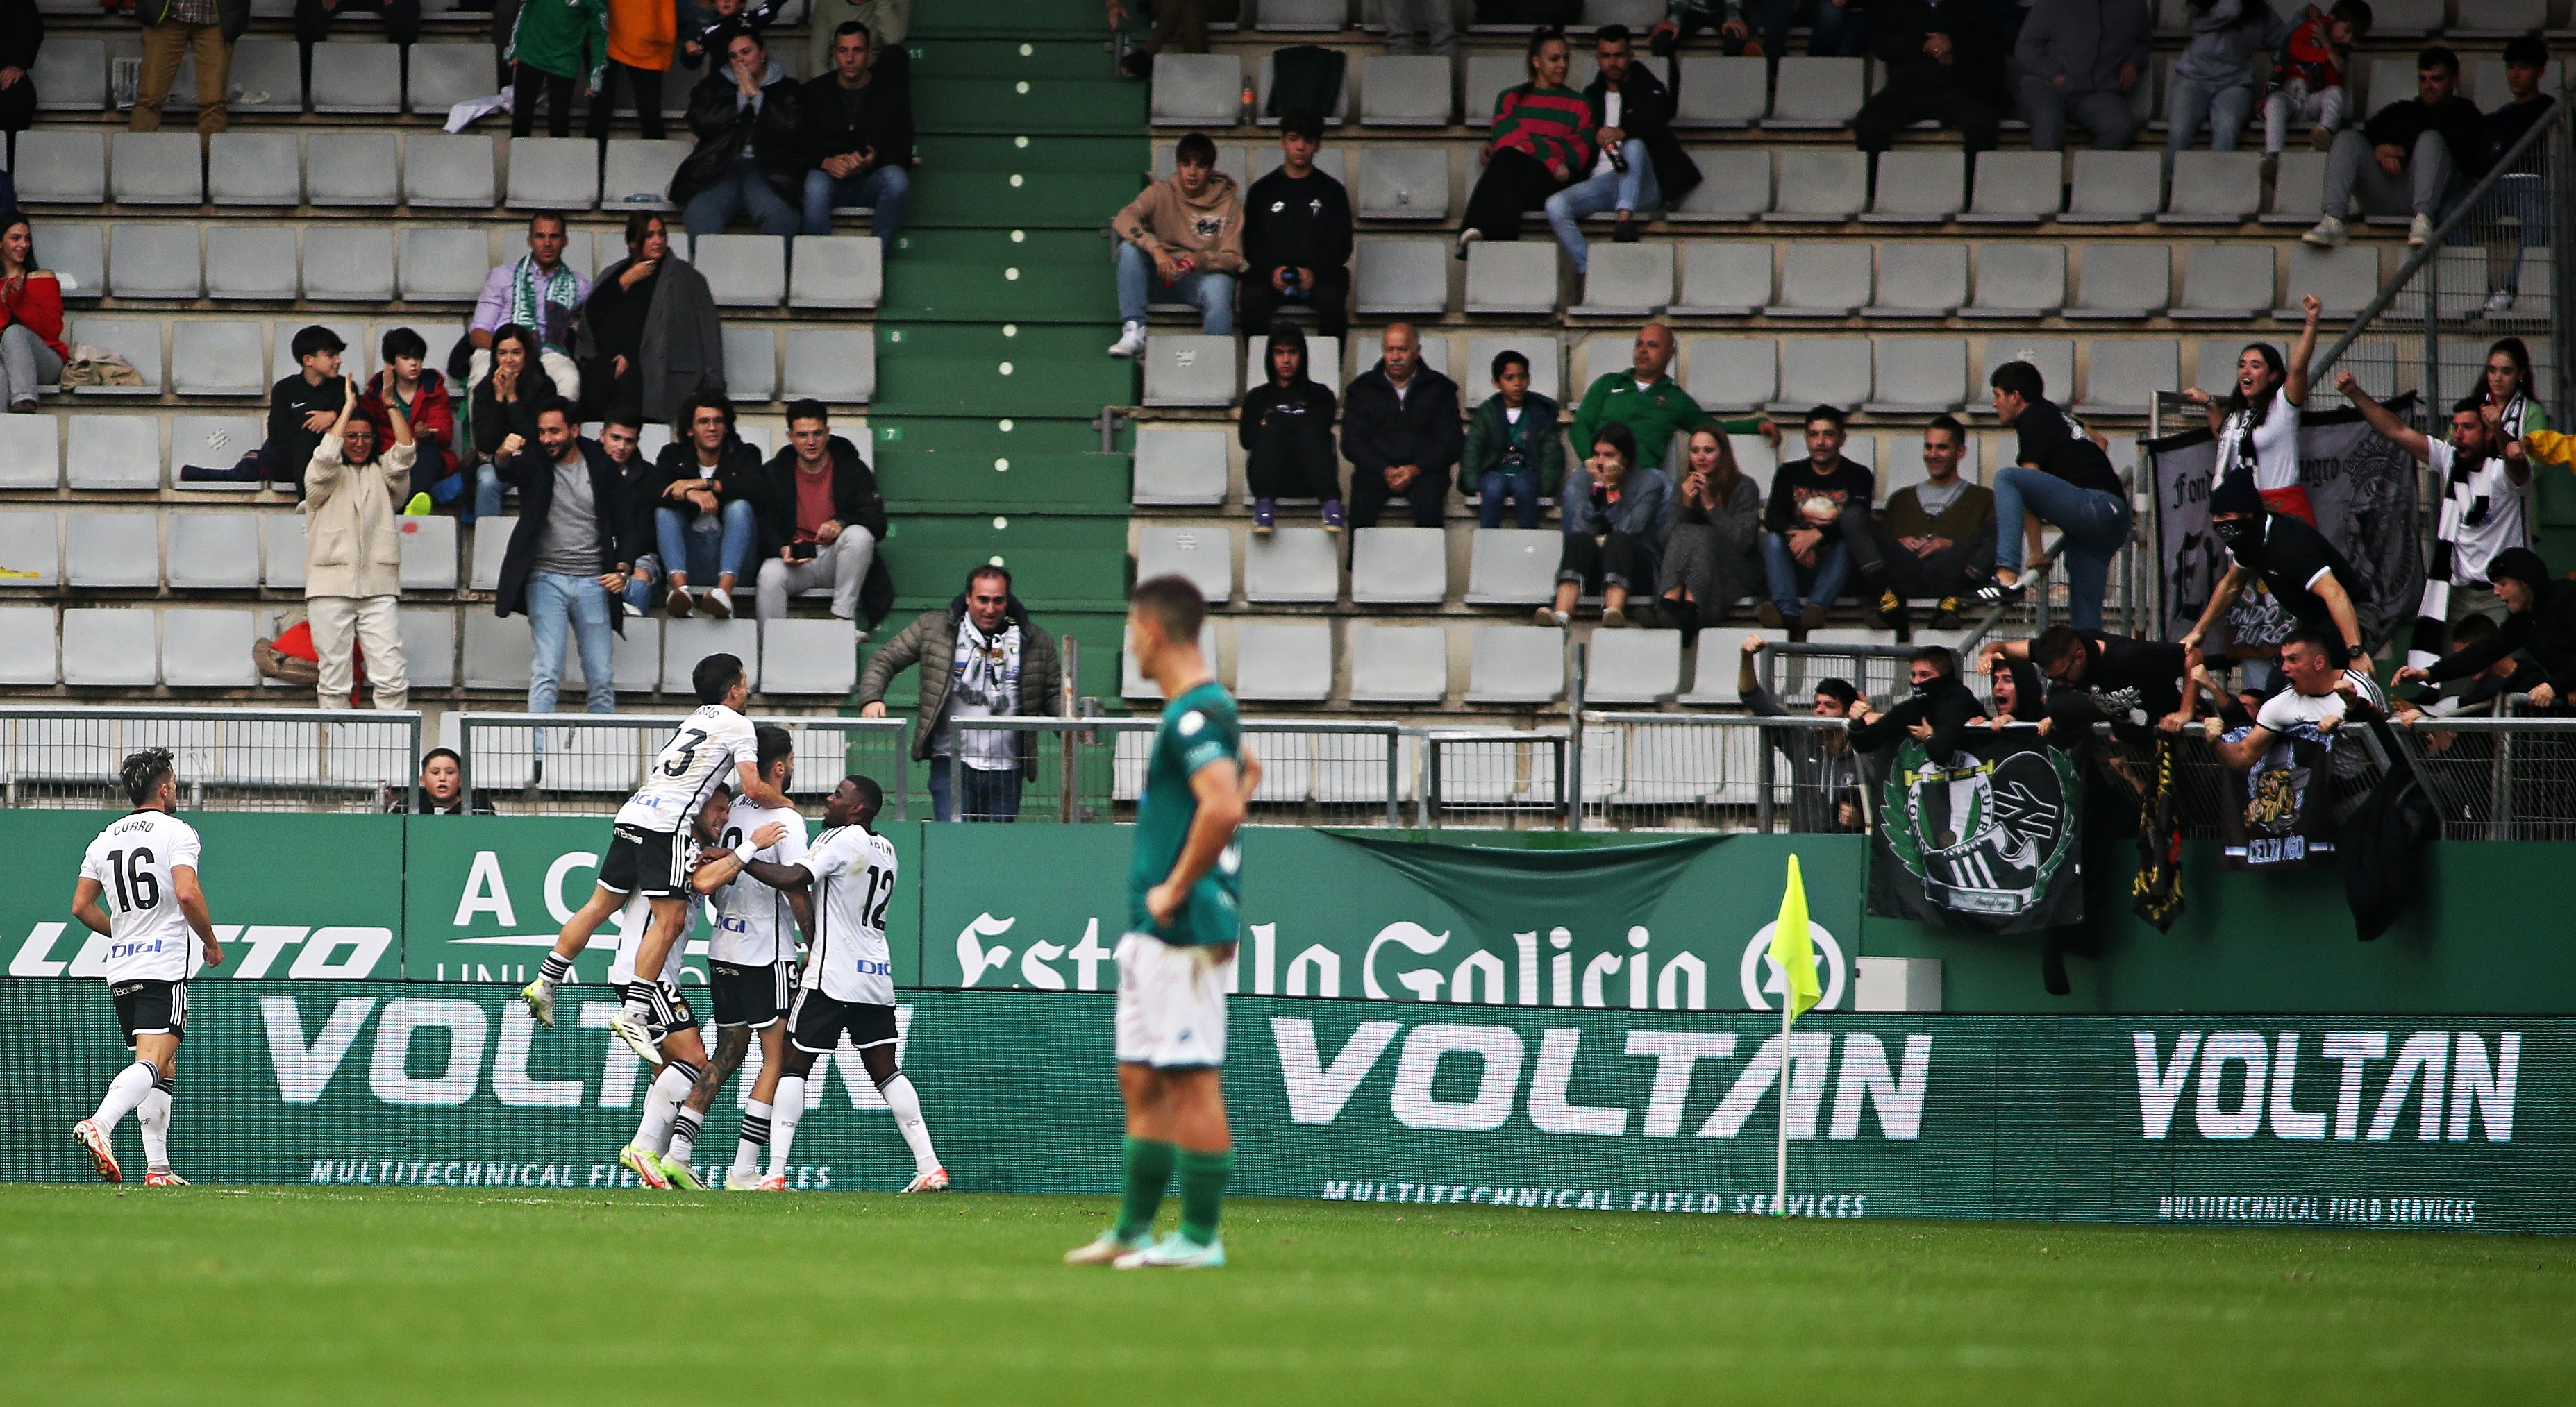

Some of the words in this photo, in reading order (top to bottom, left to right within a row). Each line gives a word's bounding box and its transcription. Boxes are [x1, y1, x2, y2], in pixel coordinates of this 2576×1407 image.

[892, 331, 901, 342] 8
[887, 429, 895, 440] 7
[2232, 623, 2293, 648] BURG
[653, 728, 708, 777] 3
[106, 846, 160, 913] 16
[861, 864, 894, 932] 12
[112, 938, 163, 959] DIGI
[788, 964, 798, 989] 9
[1362, 921, 1707, 1010] Galicia
[1271, 1016, 1934, 1141] VOLTAN
[2132, 1029, 2523, 1143] VOLTAN
[310, 1159, 574, 1188] MULTITECHNICAL
[1323, 1179, 1614, 1211] MULTITECHNICAL
[1631, 1190, 1722, 1214] FIELD
[2157, 1195, 2320, 1219] MULTITECHNICAL
[2327, 1197, 2382, 1222] FIELD
[2389, 1198, 2477, 1224] SERVICES
